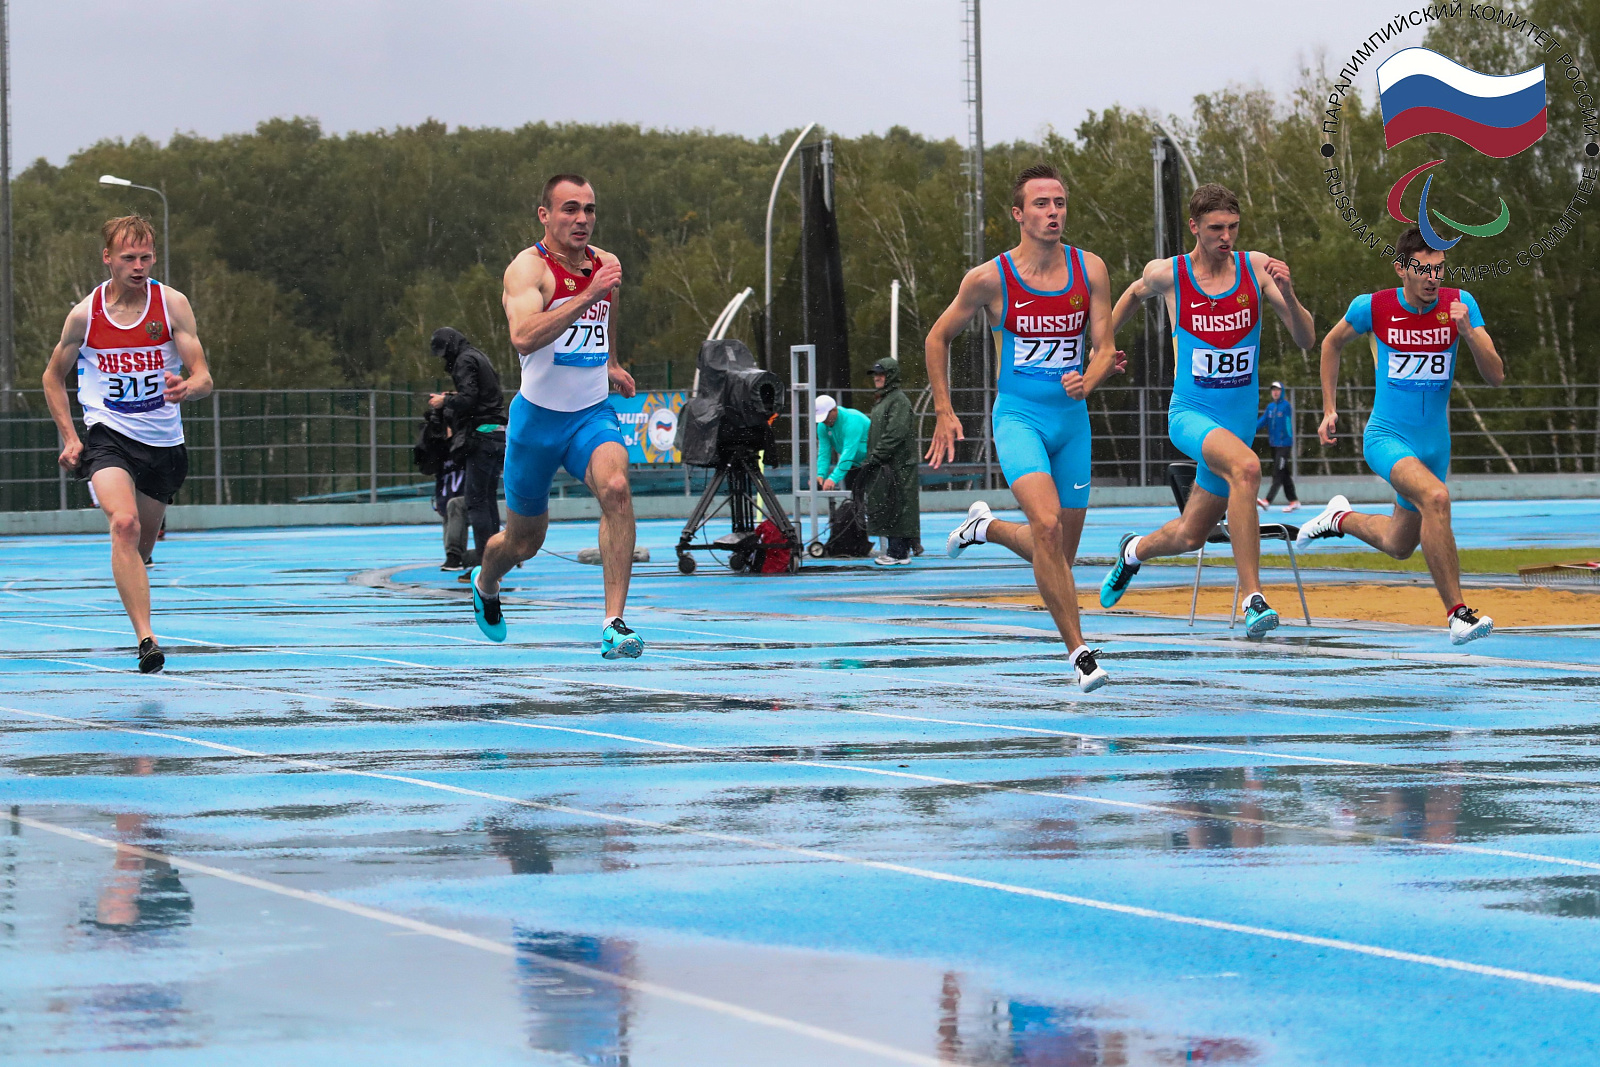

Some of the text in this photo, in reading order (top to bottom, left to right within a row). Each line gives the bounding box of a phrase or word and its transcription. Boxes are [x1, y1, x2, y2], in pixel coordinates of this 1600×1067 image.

[1016, 311, 1085, 333] RUSSIA
[1192, 308, 1251, 332] RUSSIA
[565, 325, 605, 347] 779
[1388, 326, 1451, 345] RUSSIA
[1022, 338, 1078, 362] 773
[97, 350, 165, 374] RUSSIA
[1205, 351, 1249, 374] 186
[1395, 355, 1445, 374] 778
[109, 374, 158, 398] 315
